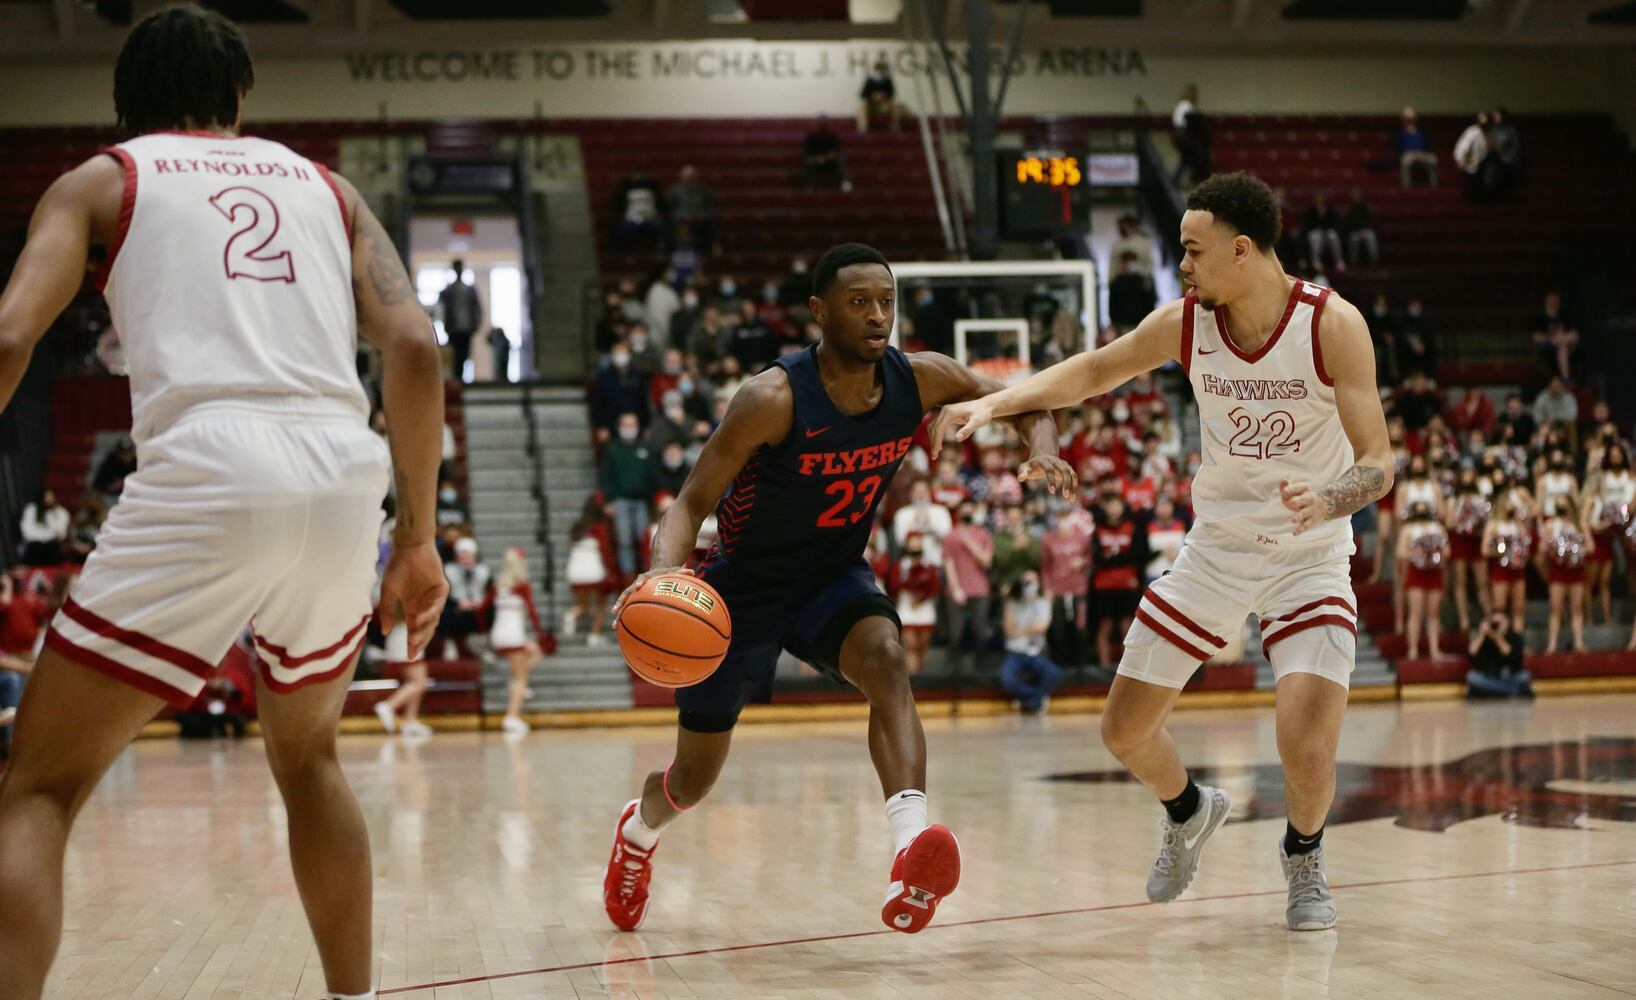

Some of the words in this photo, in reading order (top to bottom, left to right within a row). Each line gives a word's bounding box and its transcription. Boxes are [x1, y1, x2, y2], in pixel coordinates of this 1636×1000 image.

[346, 50, 519, 80] WELCOME
[531, 50, 576, 80] TO
[585, 49, 639, 79] THE
[652, 49, 799, 79] MICHAEL
[813, 50, 835, 78] J.
[1035, 47, 1148, 77] ARENA
[154, 158, 288, 178] REYNOLDS
[295, 165, 311, 182] II
[208, 186, 296, 284] 2
[1202, 373, 1308, 401] HAWKS
[1228, 406, 1300, 460] 22
[798, 436, 913, 476] FLYERS
[815, 474, 882, 528] 23
[655, 581, 715, 612] ELITE
